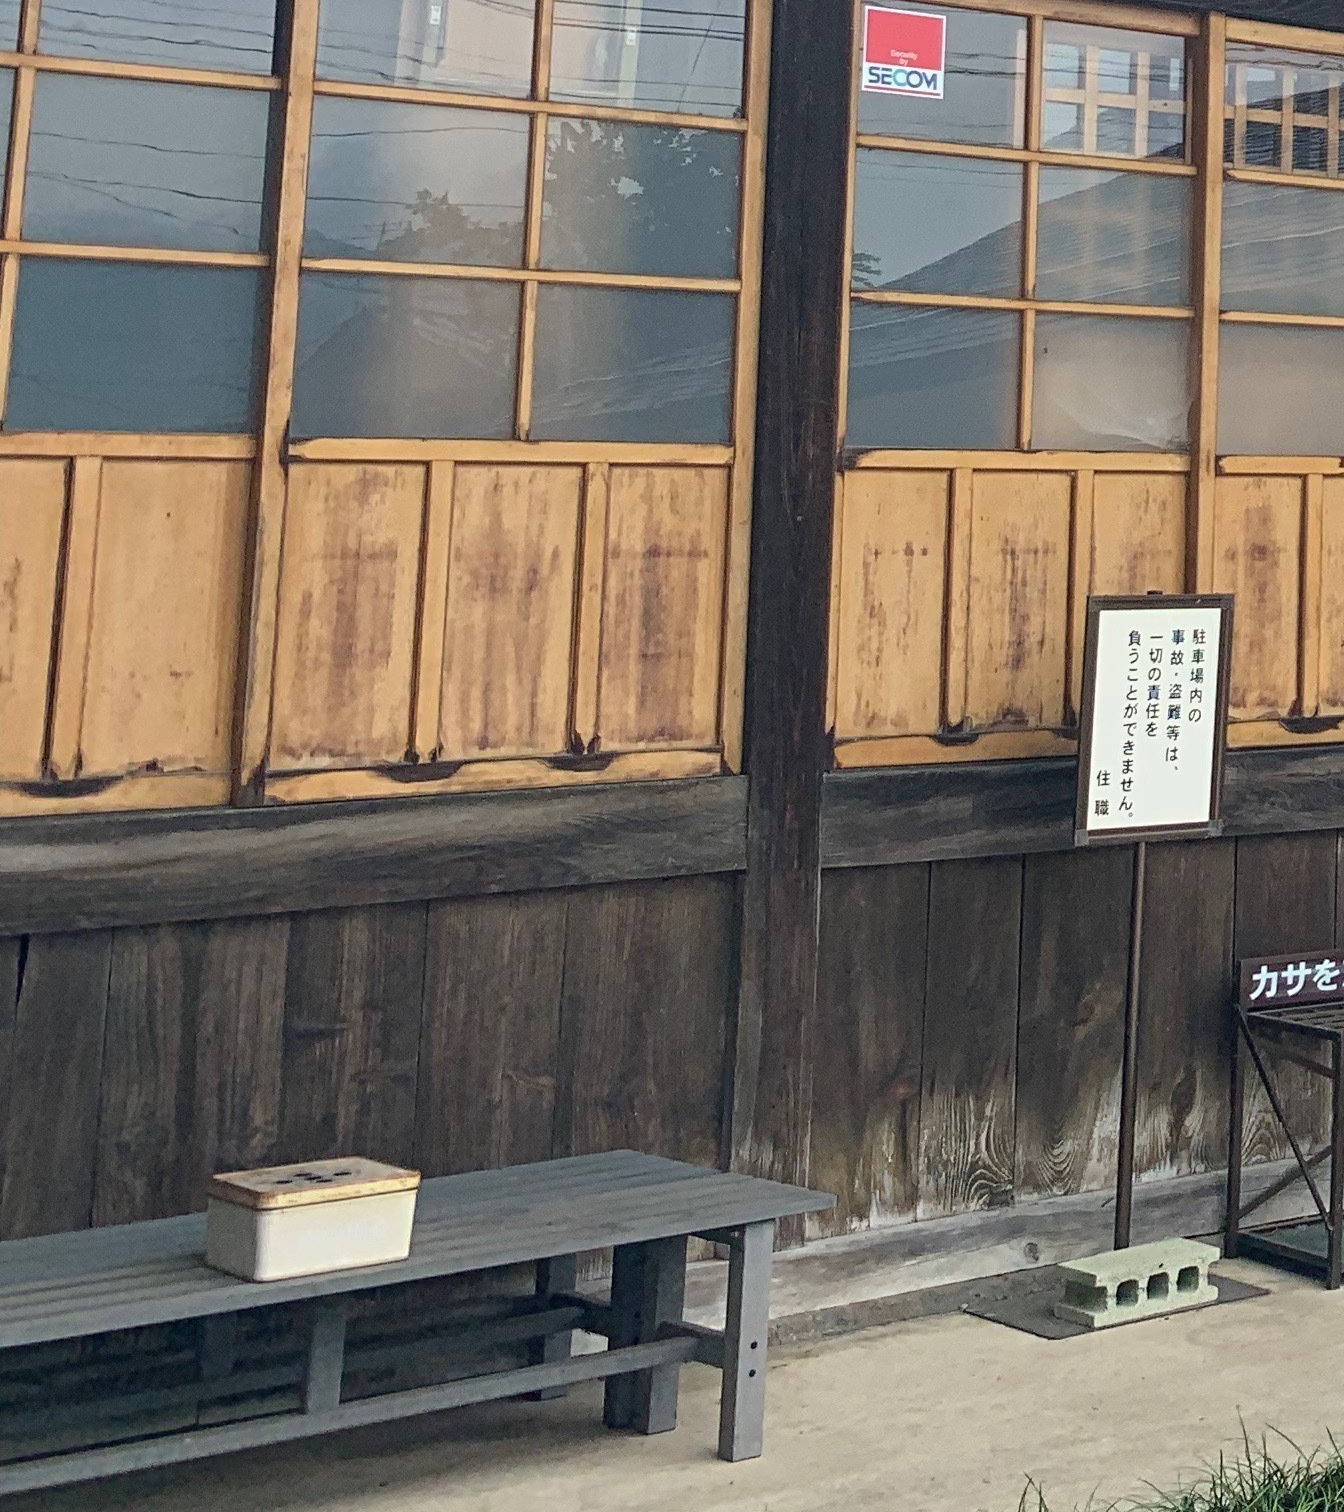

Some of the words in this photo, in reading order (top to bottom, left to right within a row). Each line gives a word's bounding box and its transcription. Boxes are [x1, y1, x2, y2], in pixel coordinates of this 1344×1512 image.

[868, 66, 937, 90] SECOM
[890, 49, 918, 61] Security
[1118, 629, 1141, 817] 負うことができません。
[1145, 635, 1163, 737] 一切の責任を
[1165, 629, 1185, 771] 事故・盗難等は、
[1188, 628, 1206, 723] 駐車場内の
